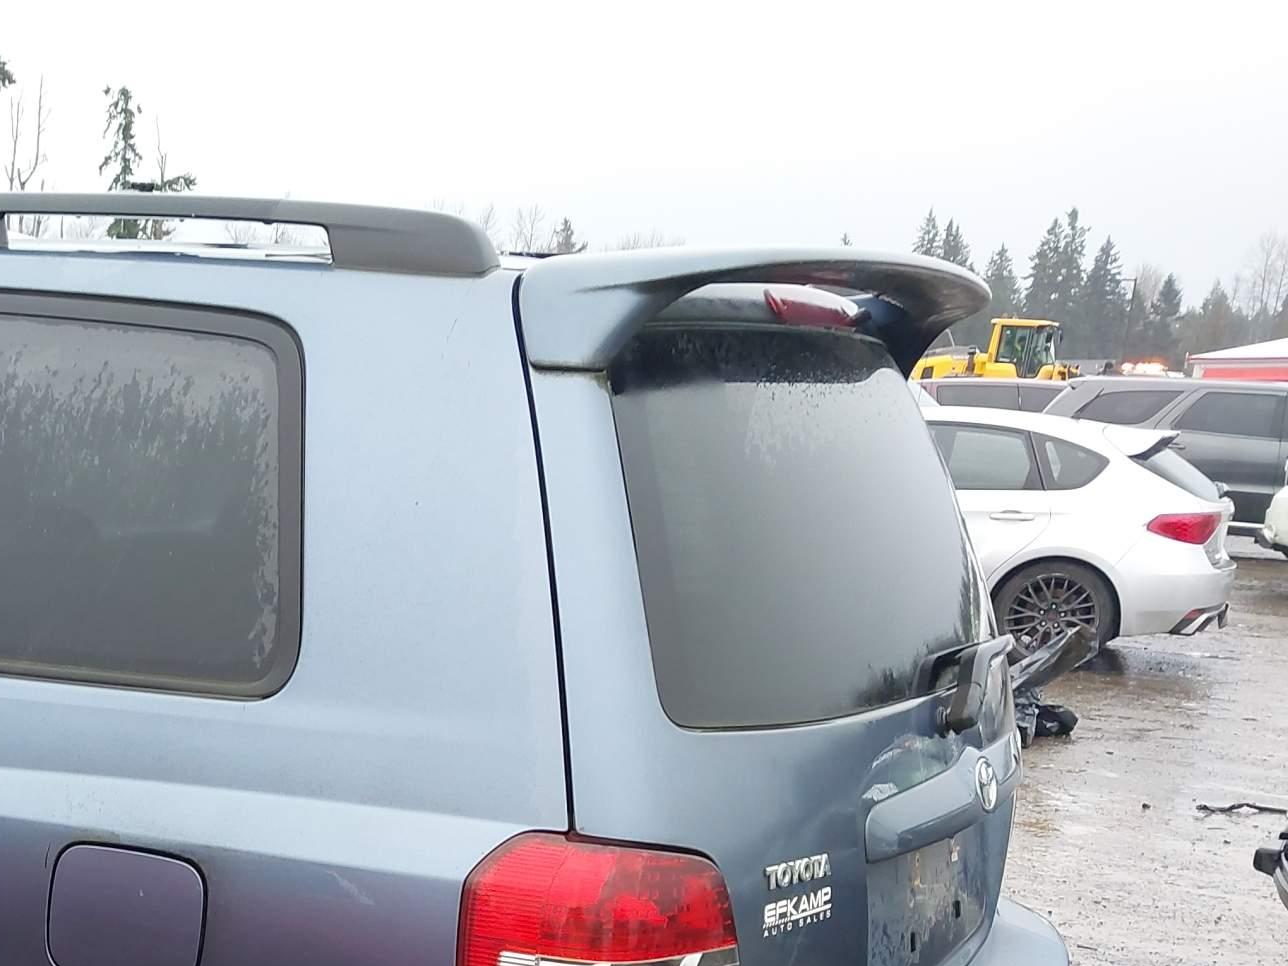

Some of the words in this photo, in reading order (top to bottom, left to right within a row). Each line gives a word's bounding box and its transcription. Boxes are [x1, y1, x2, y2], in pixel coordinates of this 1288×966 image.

[765, 853, 832, 889] TOYOTA
[764, 886, 831, 923] EFKAMP
[763, 922, 793, 938] AUTO
[798, 909, 831, 928] SALES
